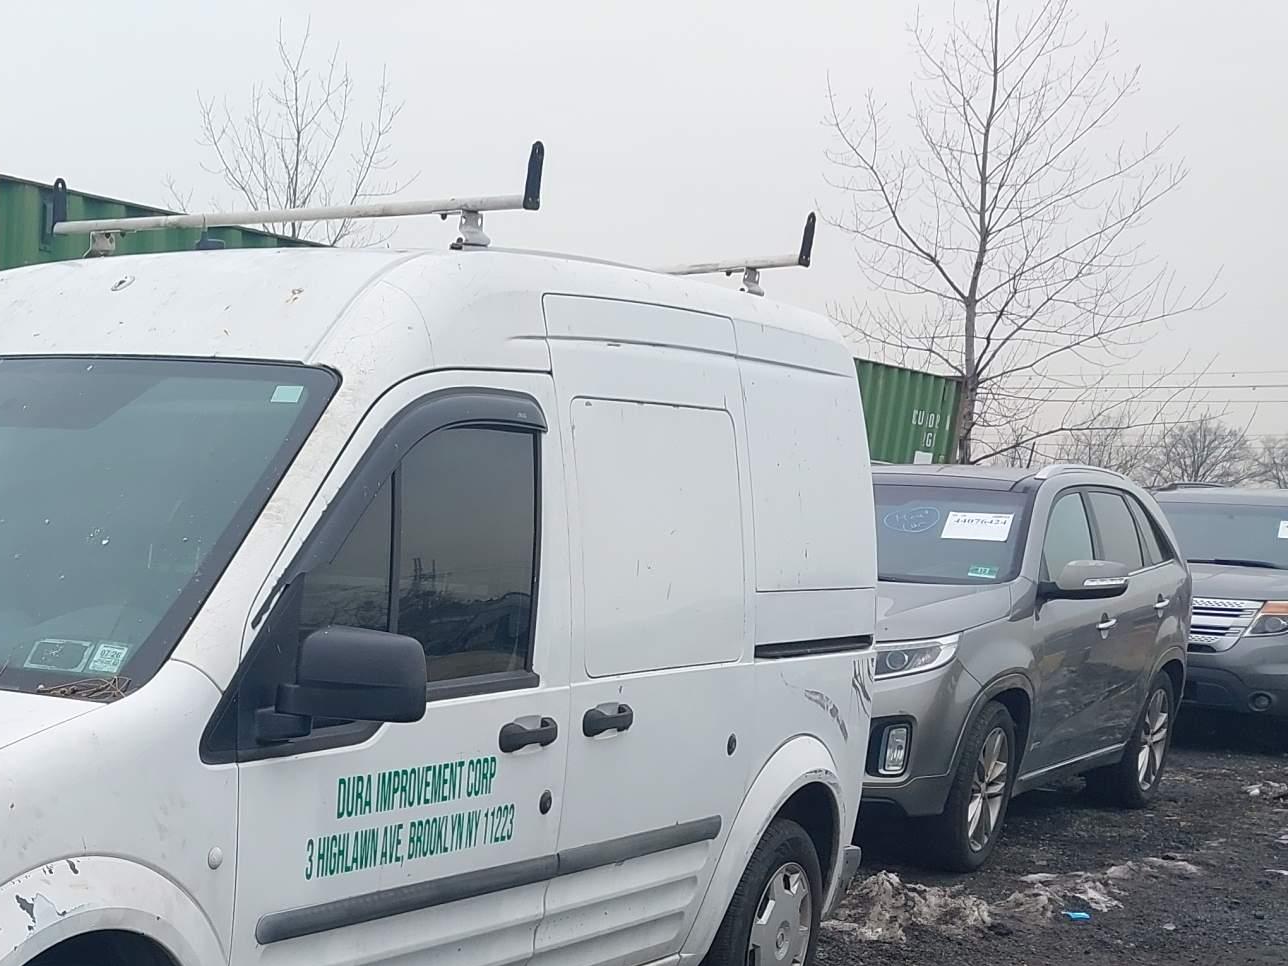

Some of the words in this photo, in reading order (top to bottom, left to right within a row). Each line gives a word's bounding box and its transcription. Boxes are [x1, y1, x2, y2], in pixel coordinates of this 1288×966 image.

[337, 775, 372, 819] DURA
[375, 761, 465, 813] IMPROVEMENT
[466, 756, 497, 797] CORP
[305, 839, 314, 880] 3
[316, 828, 379, 878] HIGHLAWN
[379, 823, 404, 868] AVE,
[407, 811, 464, 860] BROOKLYN
[464, 809, 481, 849] NY
[483, 803, 515, 845] 11223
